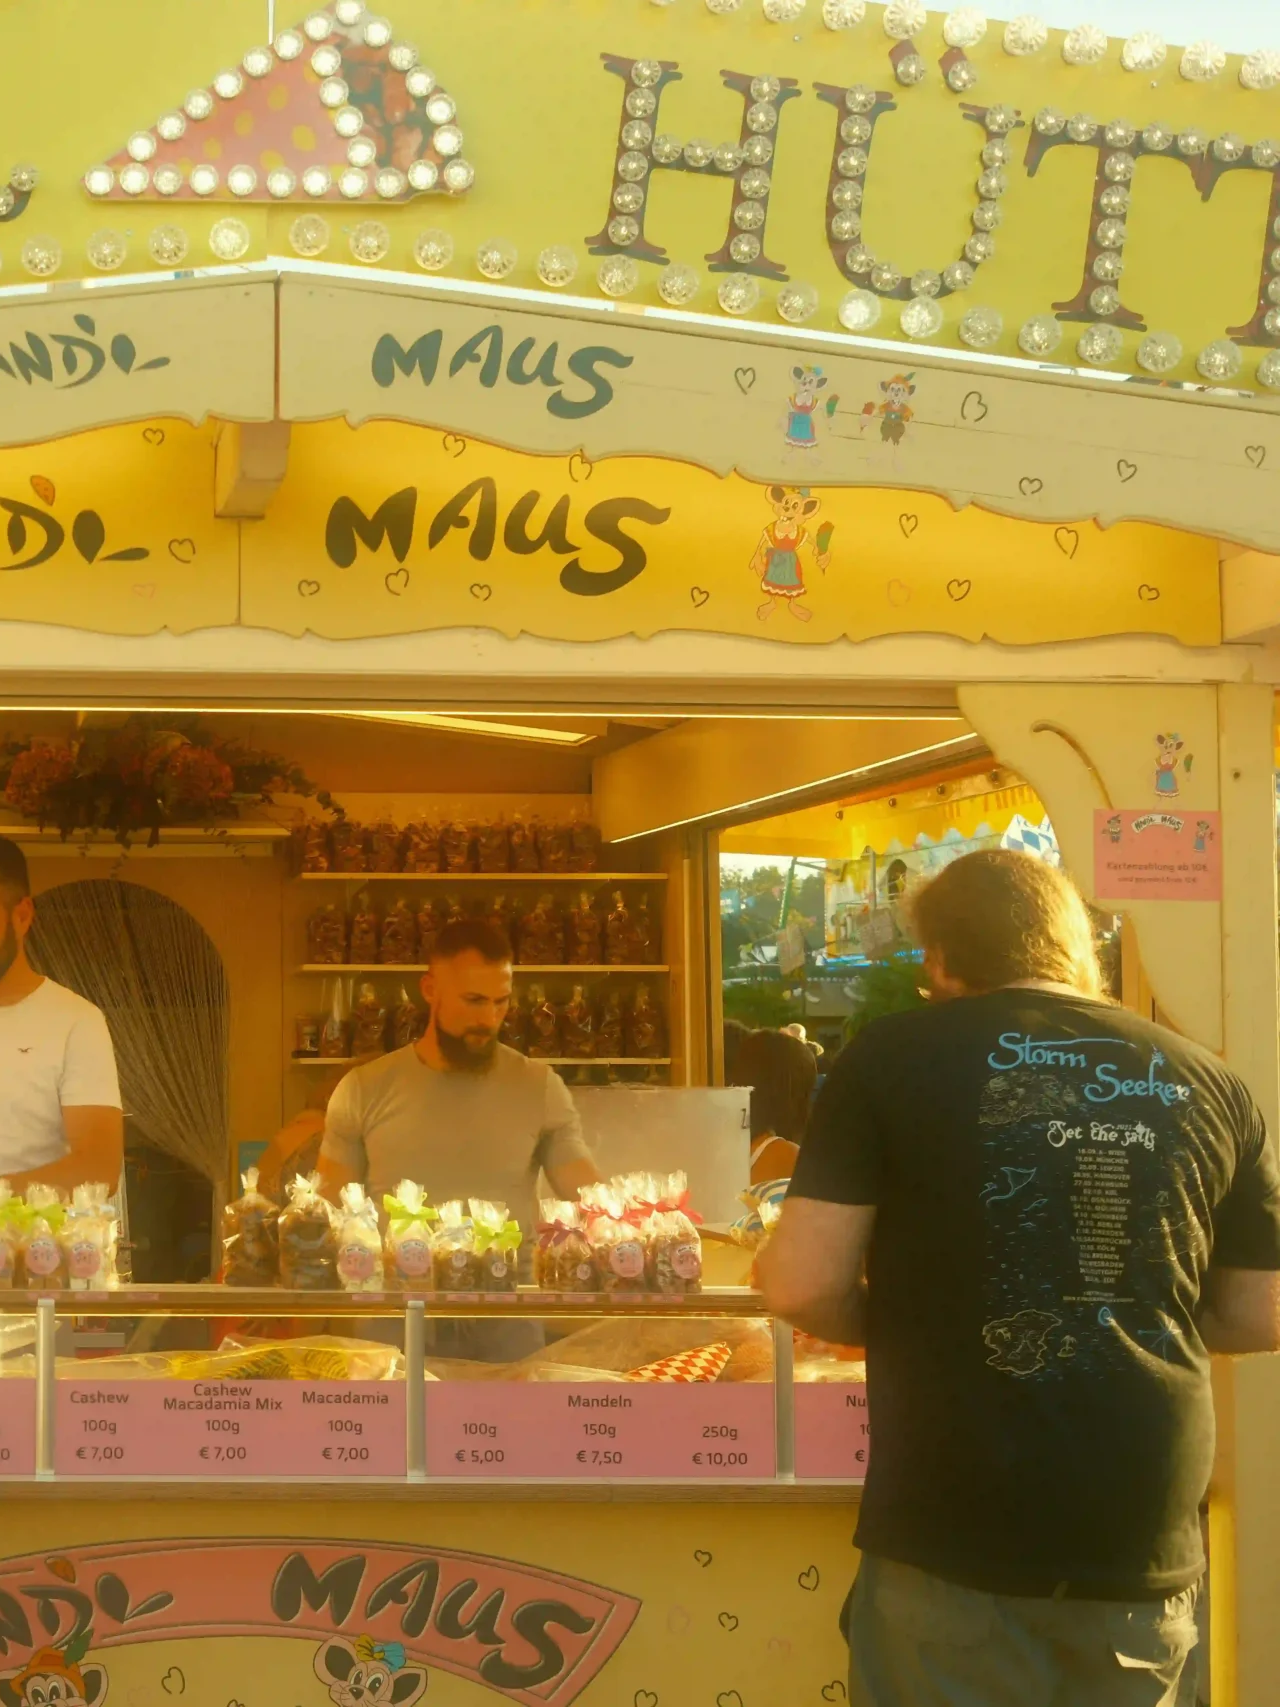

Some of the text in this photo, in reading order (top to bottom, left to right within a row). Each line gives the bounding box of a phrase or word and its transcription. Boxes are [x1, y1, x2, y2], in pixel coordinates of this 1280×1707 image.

[371, 324, 634, 420] MAUS
[324, 475, 671, 597] MAUS
[1107, 862, 1175, 873] Kartenzahlung
[987, 1032, 1125, 1070] Storm
[1083, 1050, 1193, 1107] Seeker
[1090, 1121, 1119, 1142] the
[70, 1390, 130, 1404] Cashew
[193, 1383, 253, 1397] Cashew
[302, 1390, 389, 1405] Macadamia
[163, 1397, 283, 1411] Macadamia Mix
[567, 1394, 632, 1408] Mandeln
[83, 1419, 363, 1435] 100g 100g 100g
[462, 1422, 738, 1440] 100g 150g 250g
[76, 1447, 124, 1461] € 7,00
[199, 1447, 247, 1461] € 7,00
[322, 1447, 370, 1462] € 7,00
[455, 1450, 505, 1465] € 5,00
[576, 1450, 623, 1466] € 7,50
[692, 1452, 748, 1467] € 10,00
[270, 1550, 596, 1690] MAUS
